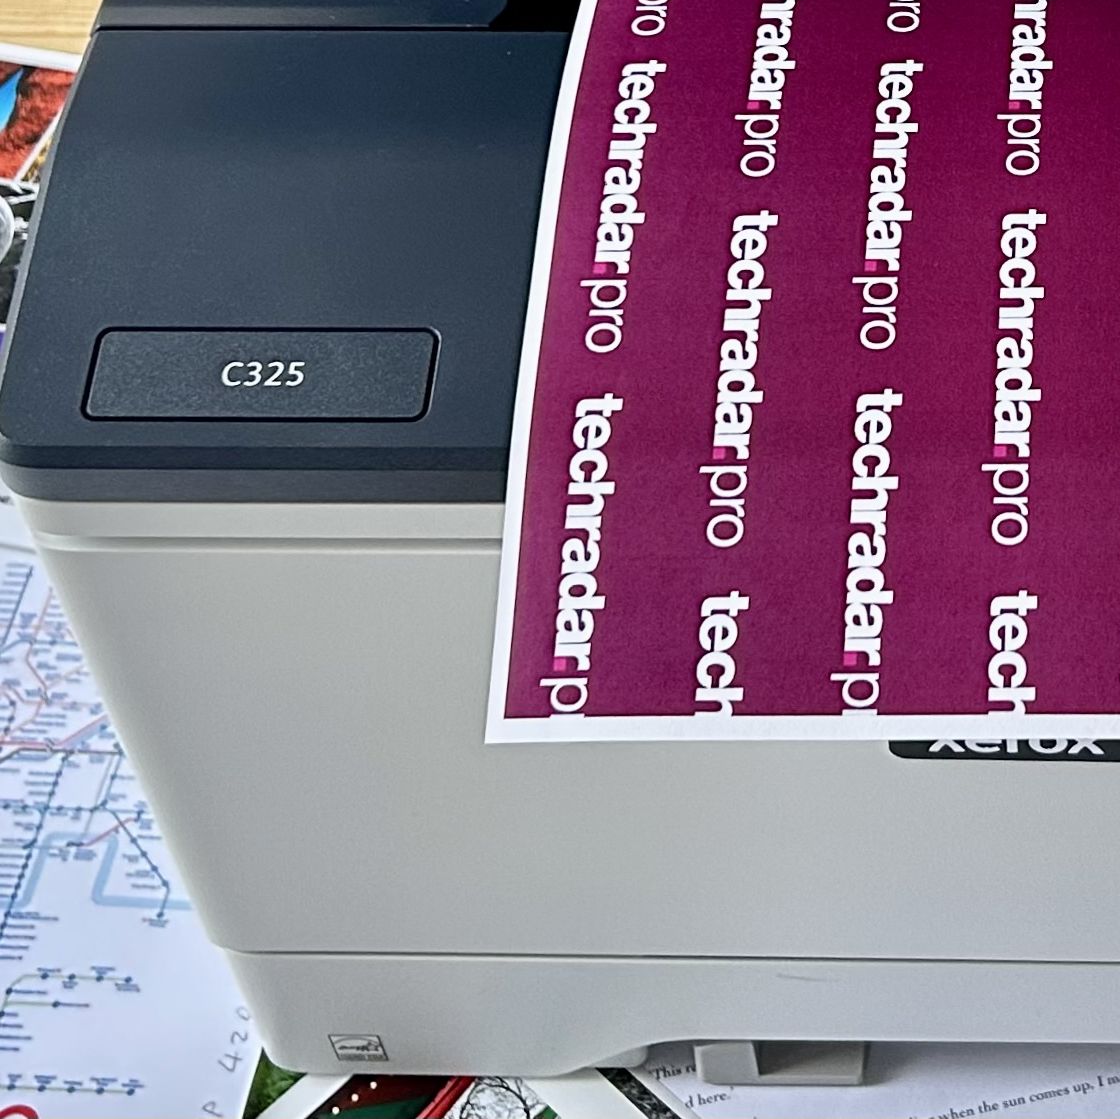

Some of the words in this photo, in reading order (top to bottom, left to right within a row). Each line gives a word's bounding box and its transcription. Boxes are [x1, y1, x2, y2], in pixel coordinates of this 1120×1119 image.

[579, 60, 667, 353] techradar.pro
[852, 60, 923, 350] techradar.pro
[221, 361, 305, 387] C325
[700, 210, 778, 547] techradar.pro
[982, 209, 1046, 545] techradar.pro
[978, 1101, 999, 1115] the
[1002, 1096, 1026, 1109] sun
[1029, 1086, 1070, 1103] comes
[1097, 1075, 1104, 1087] I
